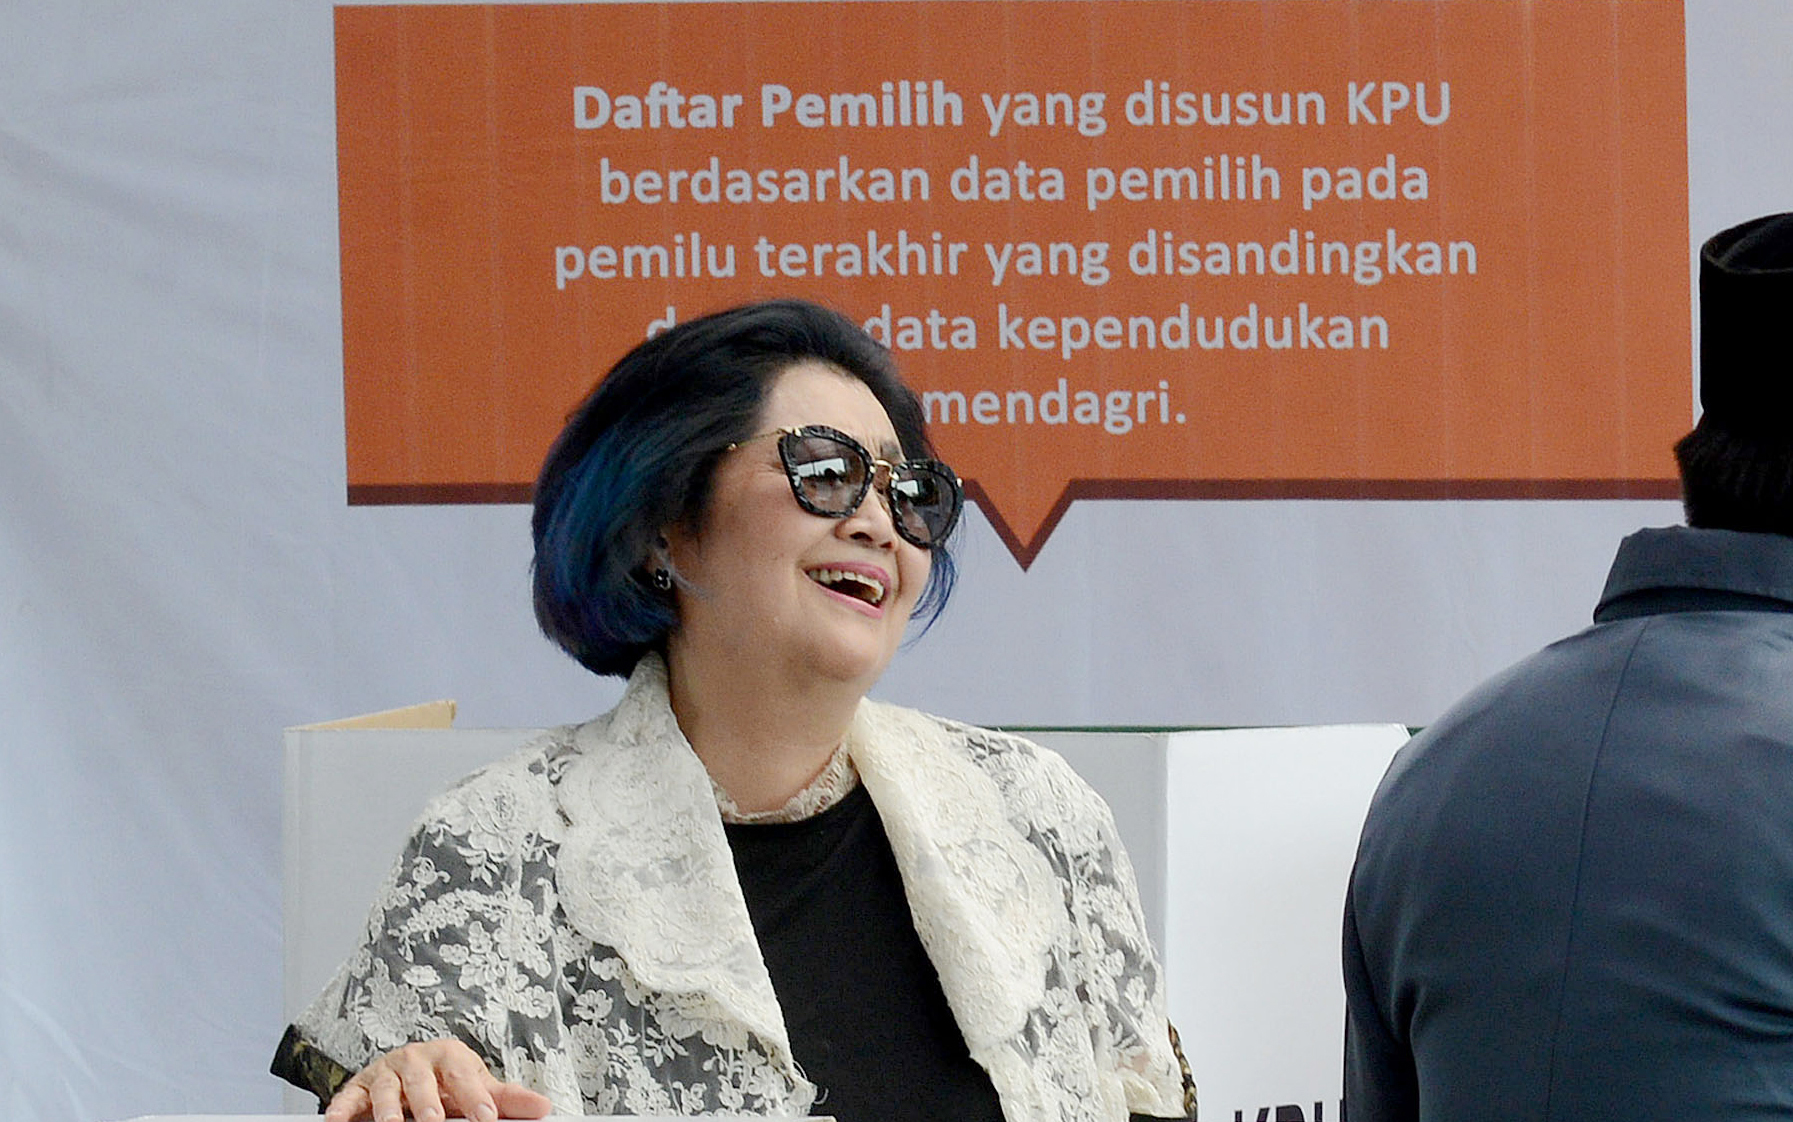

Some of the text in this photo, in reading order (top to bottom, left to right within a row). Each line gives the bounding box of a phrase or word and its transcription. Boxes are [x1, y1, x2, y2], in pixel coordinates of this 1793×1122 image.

[574, 79, 1450, 137] Daftar Pemilih yang disusun KPU
[601, 154, 1428, 211] berdasarkan data pemilih pada
[555, 228, 1477, 290] pemilu terakhir yang disandingkan
[864, 302, 1389, 360] data kependudukan
[924, 378, 1186, 434] mendagri.
